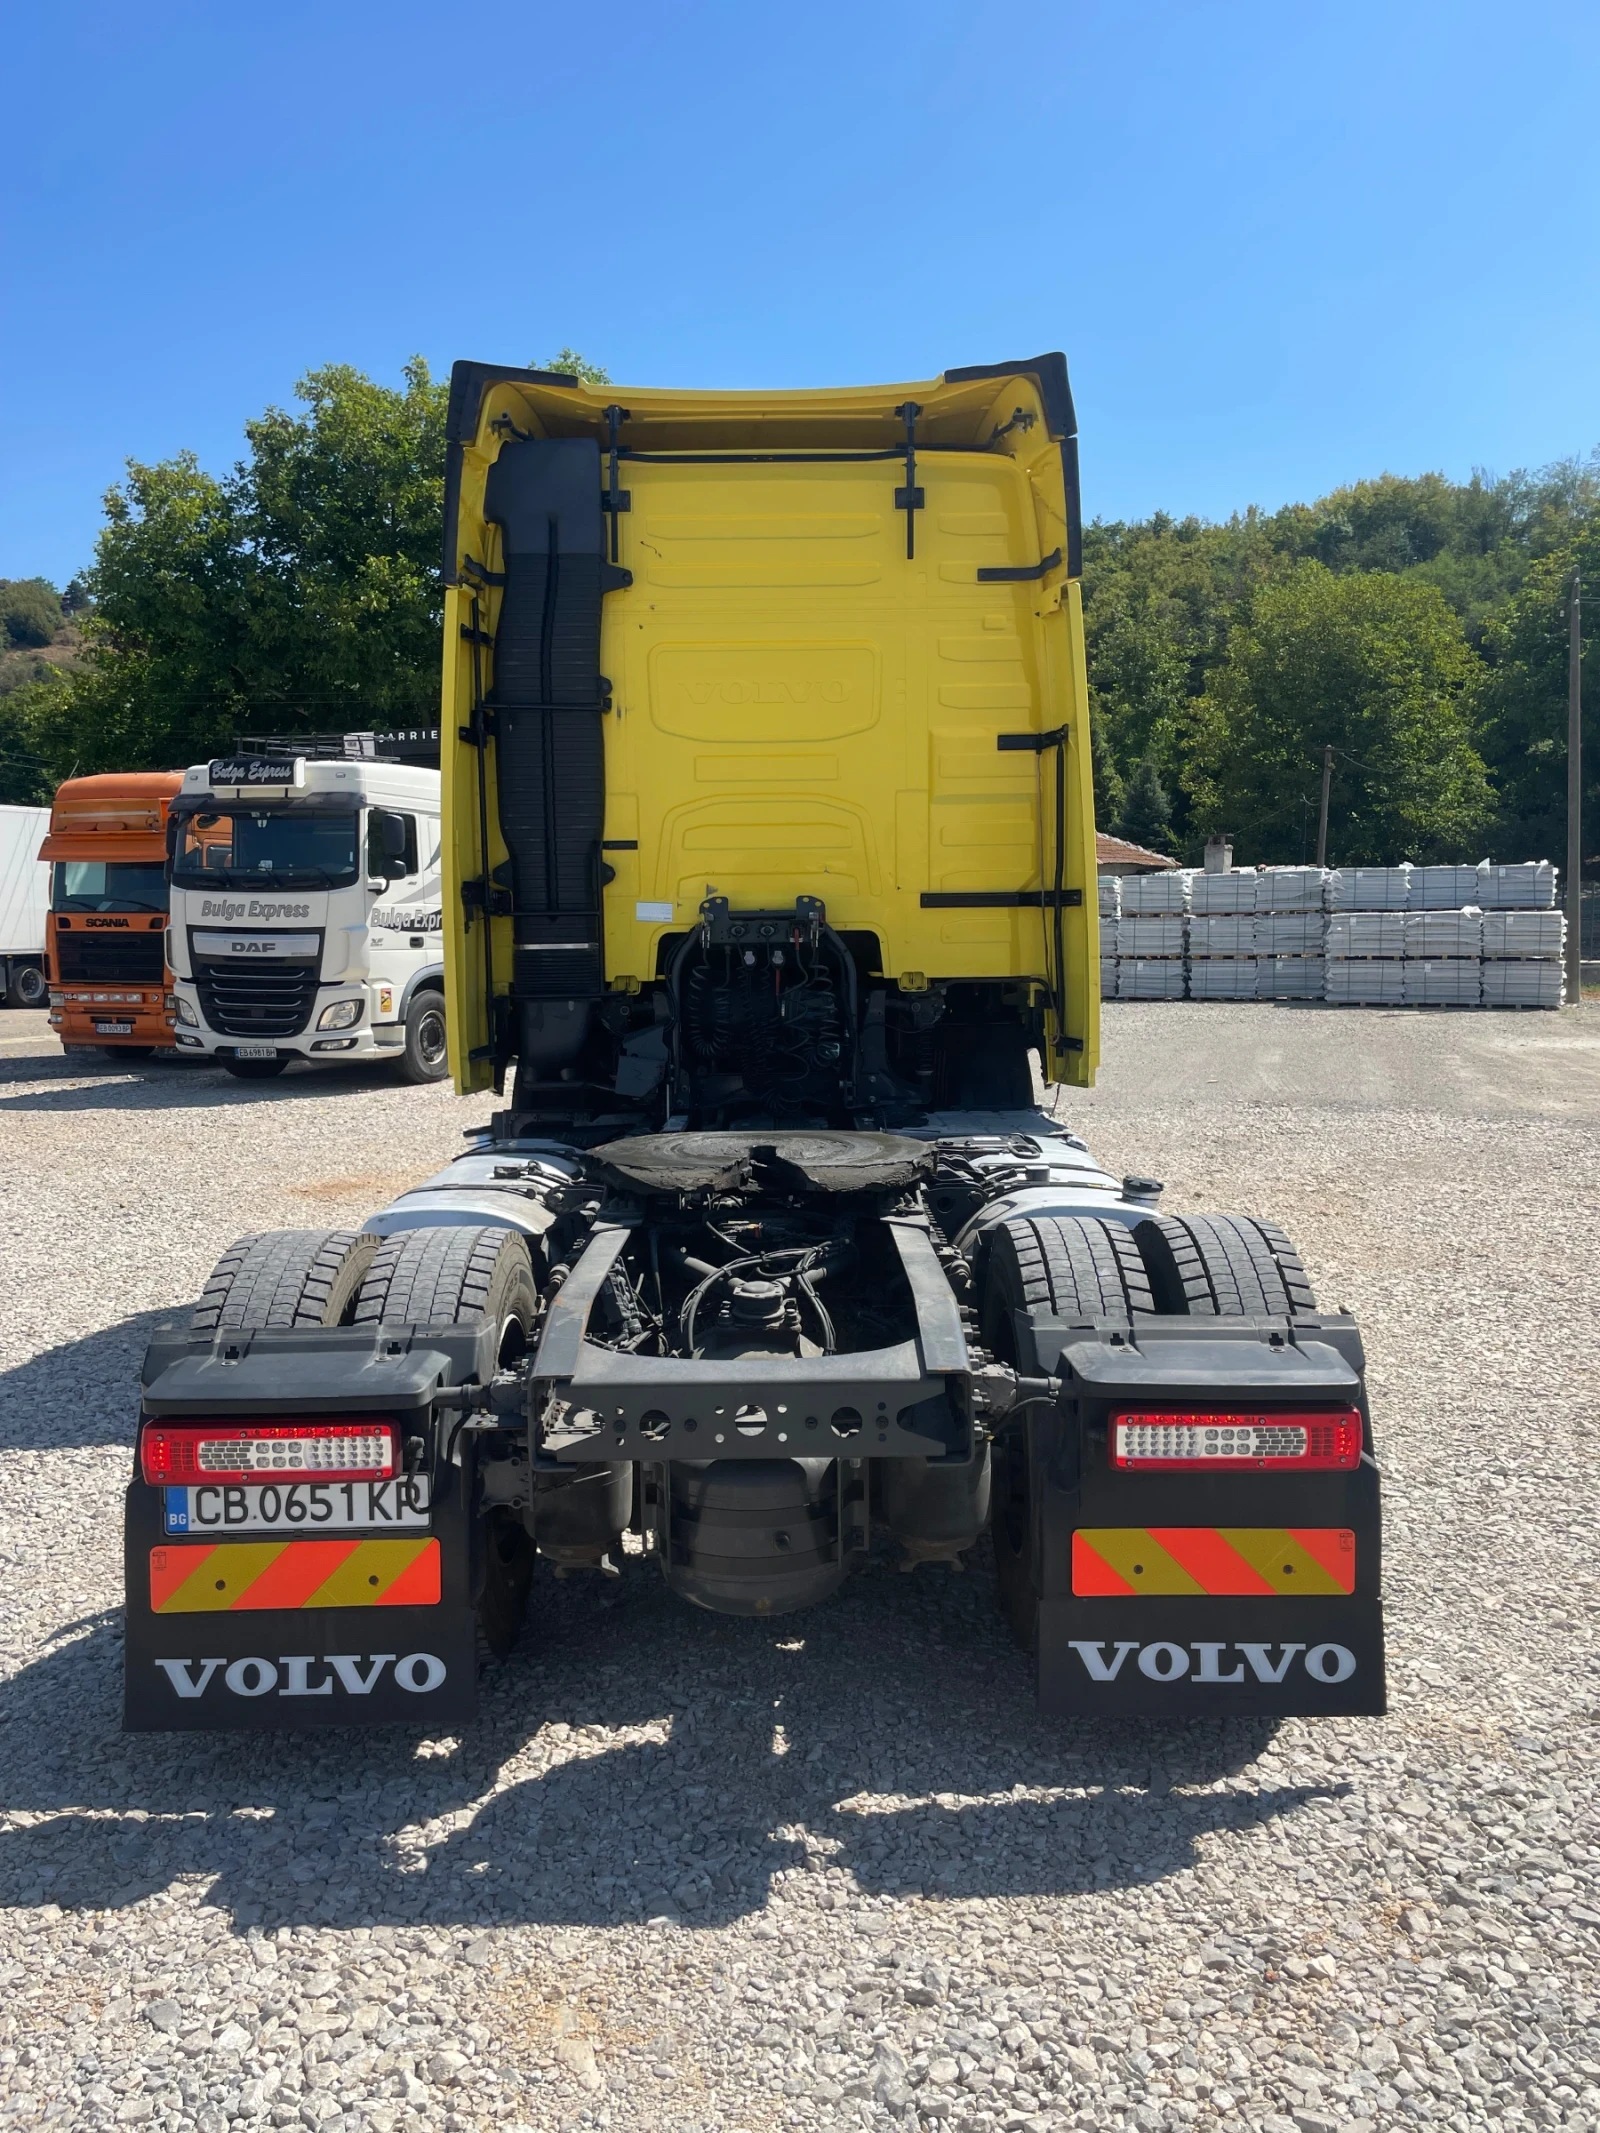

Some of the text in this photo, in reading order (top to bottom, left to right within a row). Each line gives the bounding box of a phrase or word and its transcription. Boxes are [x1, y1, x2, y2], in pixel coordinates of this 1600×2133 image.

[676, 679, 853, 705] VOLVO
[211, 761, 292, 784] Bulga Express
[201, 899, 310, 922] Bulga Express
[370, 907, 411, 933] Bulga
[85, 918, 130, 928] SCANIA
[231, 942, 276, 953] DAF
[168, 1513, 187, 1526] BG
[1068, 1640, 1357, 1684] VOLVO
[154, 1652, 447, 1698] VOLVO
